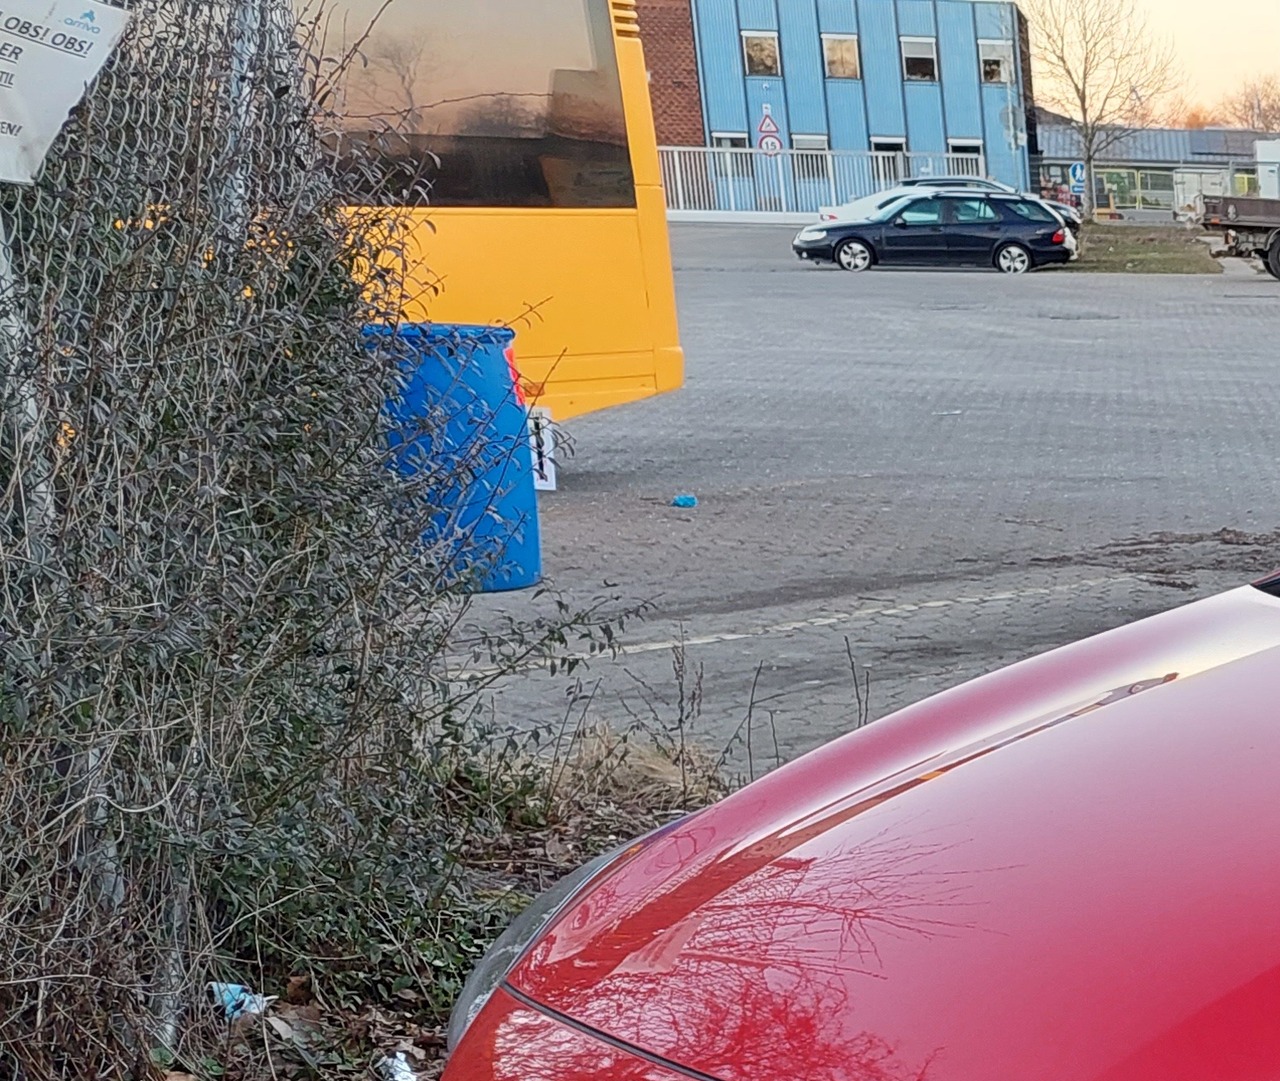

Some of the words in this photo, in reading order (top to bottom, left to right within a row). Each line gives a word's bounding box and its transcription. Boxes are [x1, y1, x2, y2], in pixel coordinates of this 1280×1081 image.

[4, 16, 51, 41] OBS!
[51, 33, 94, 55] OBS!
[764, 141, 777, 150] 15
